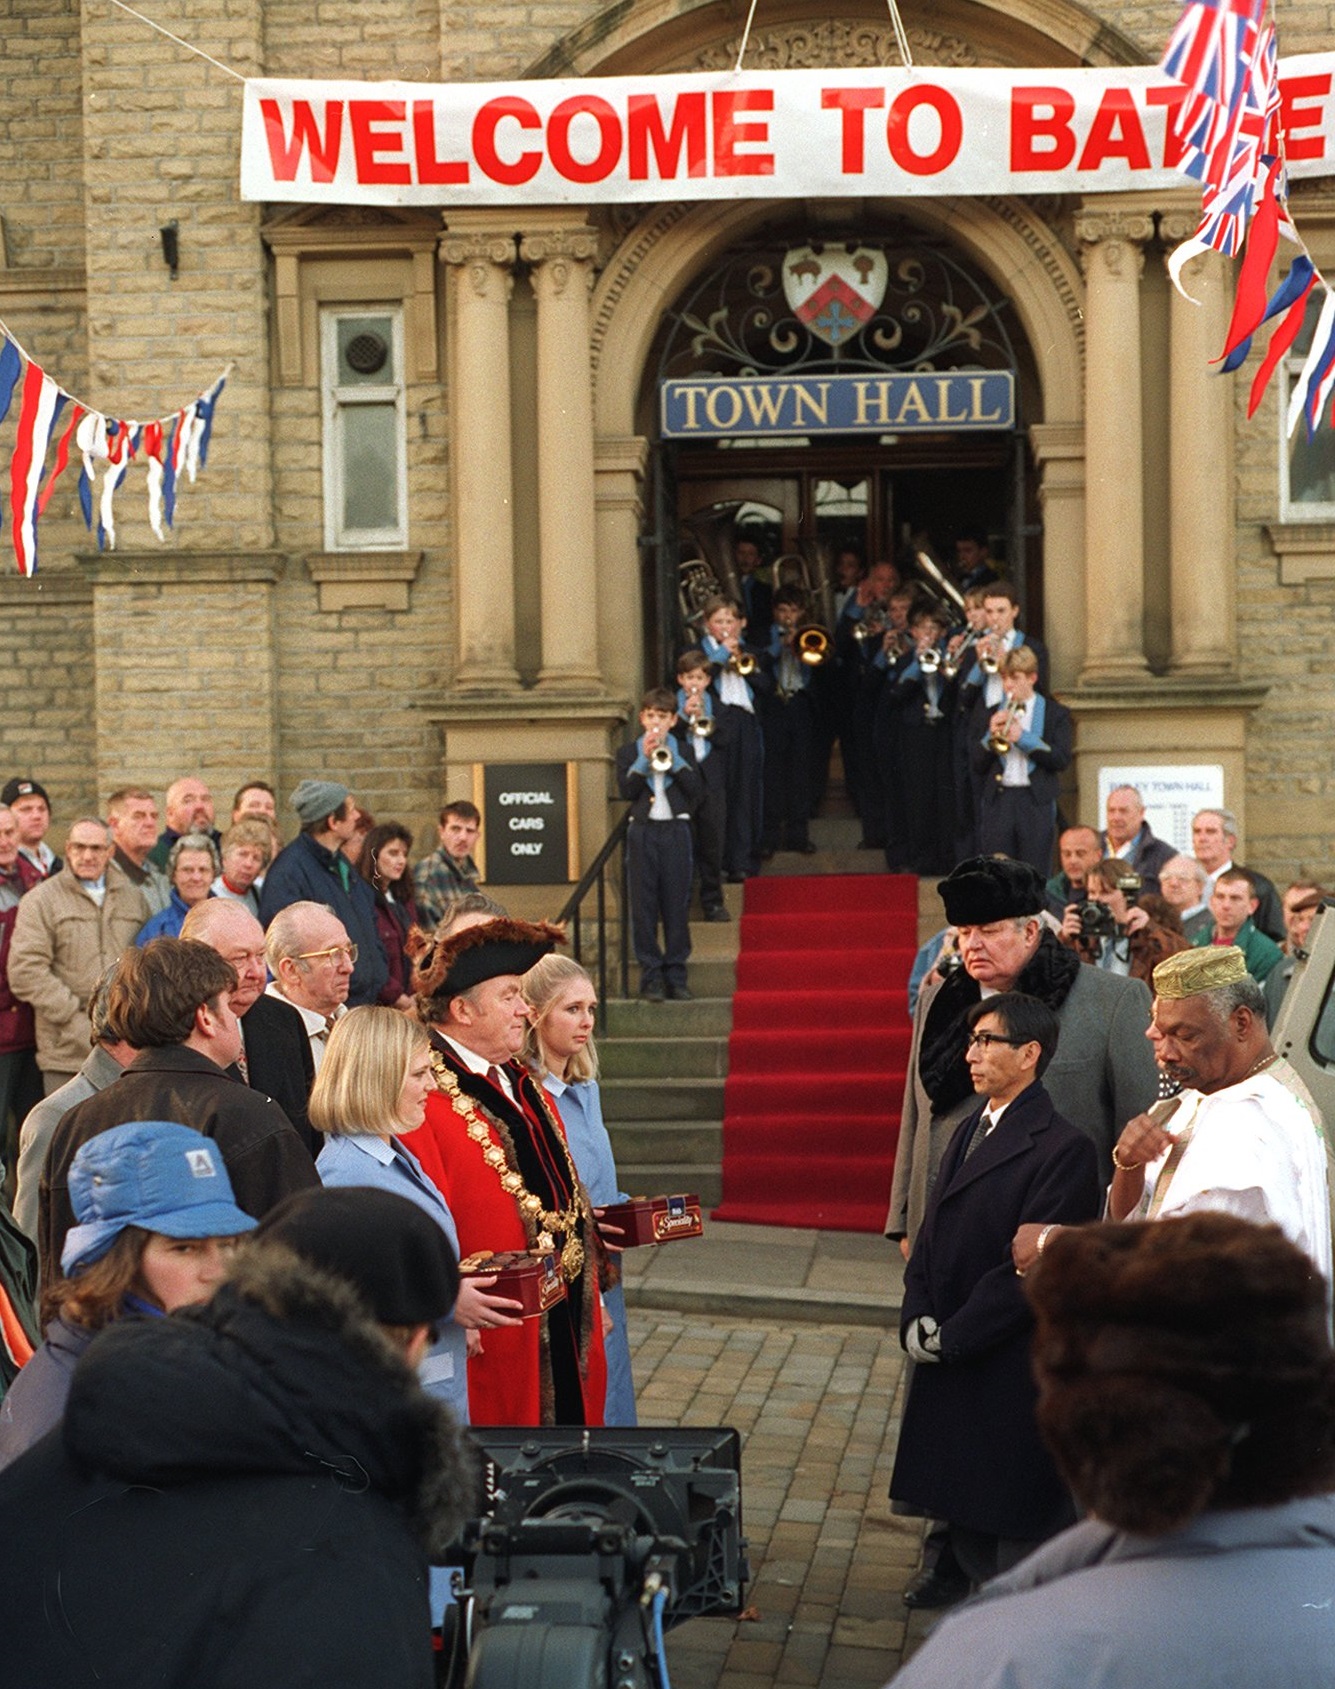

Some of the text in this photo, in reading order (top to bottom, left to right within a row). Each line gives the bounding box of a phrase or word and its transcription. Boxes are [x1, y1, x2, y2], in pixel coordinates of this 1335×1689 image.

[259, 90, 774, 185] WELCOME
[822, 84, 963, 175] TO
[674, 380, 1001, 429] TOWN HALL
[499, 792, 554, 806] OFFICIAL
[508, 817, 545, 831] CARS
[510, 842, 543, 856] ONLY
